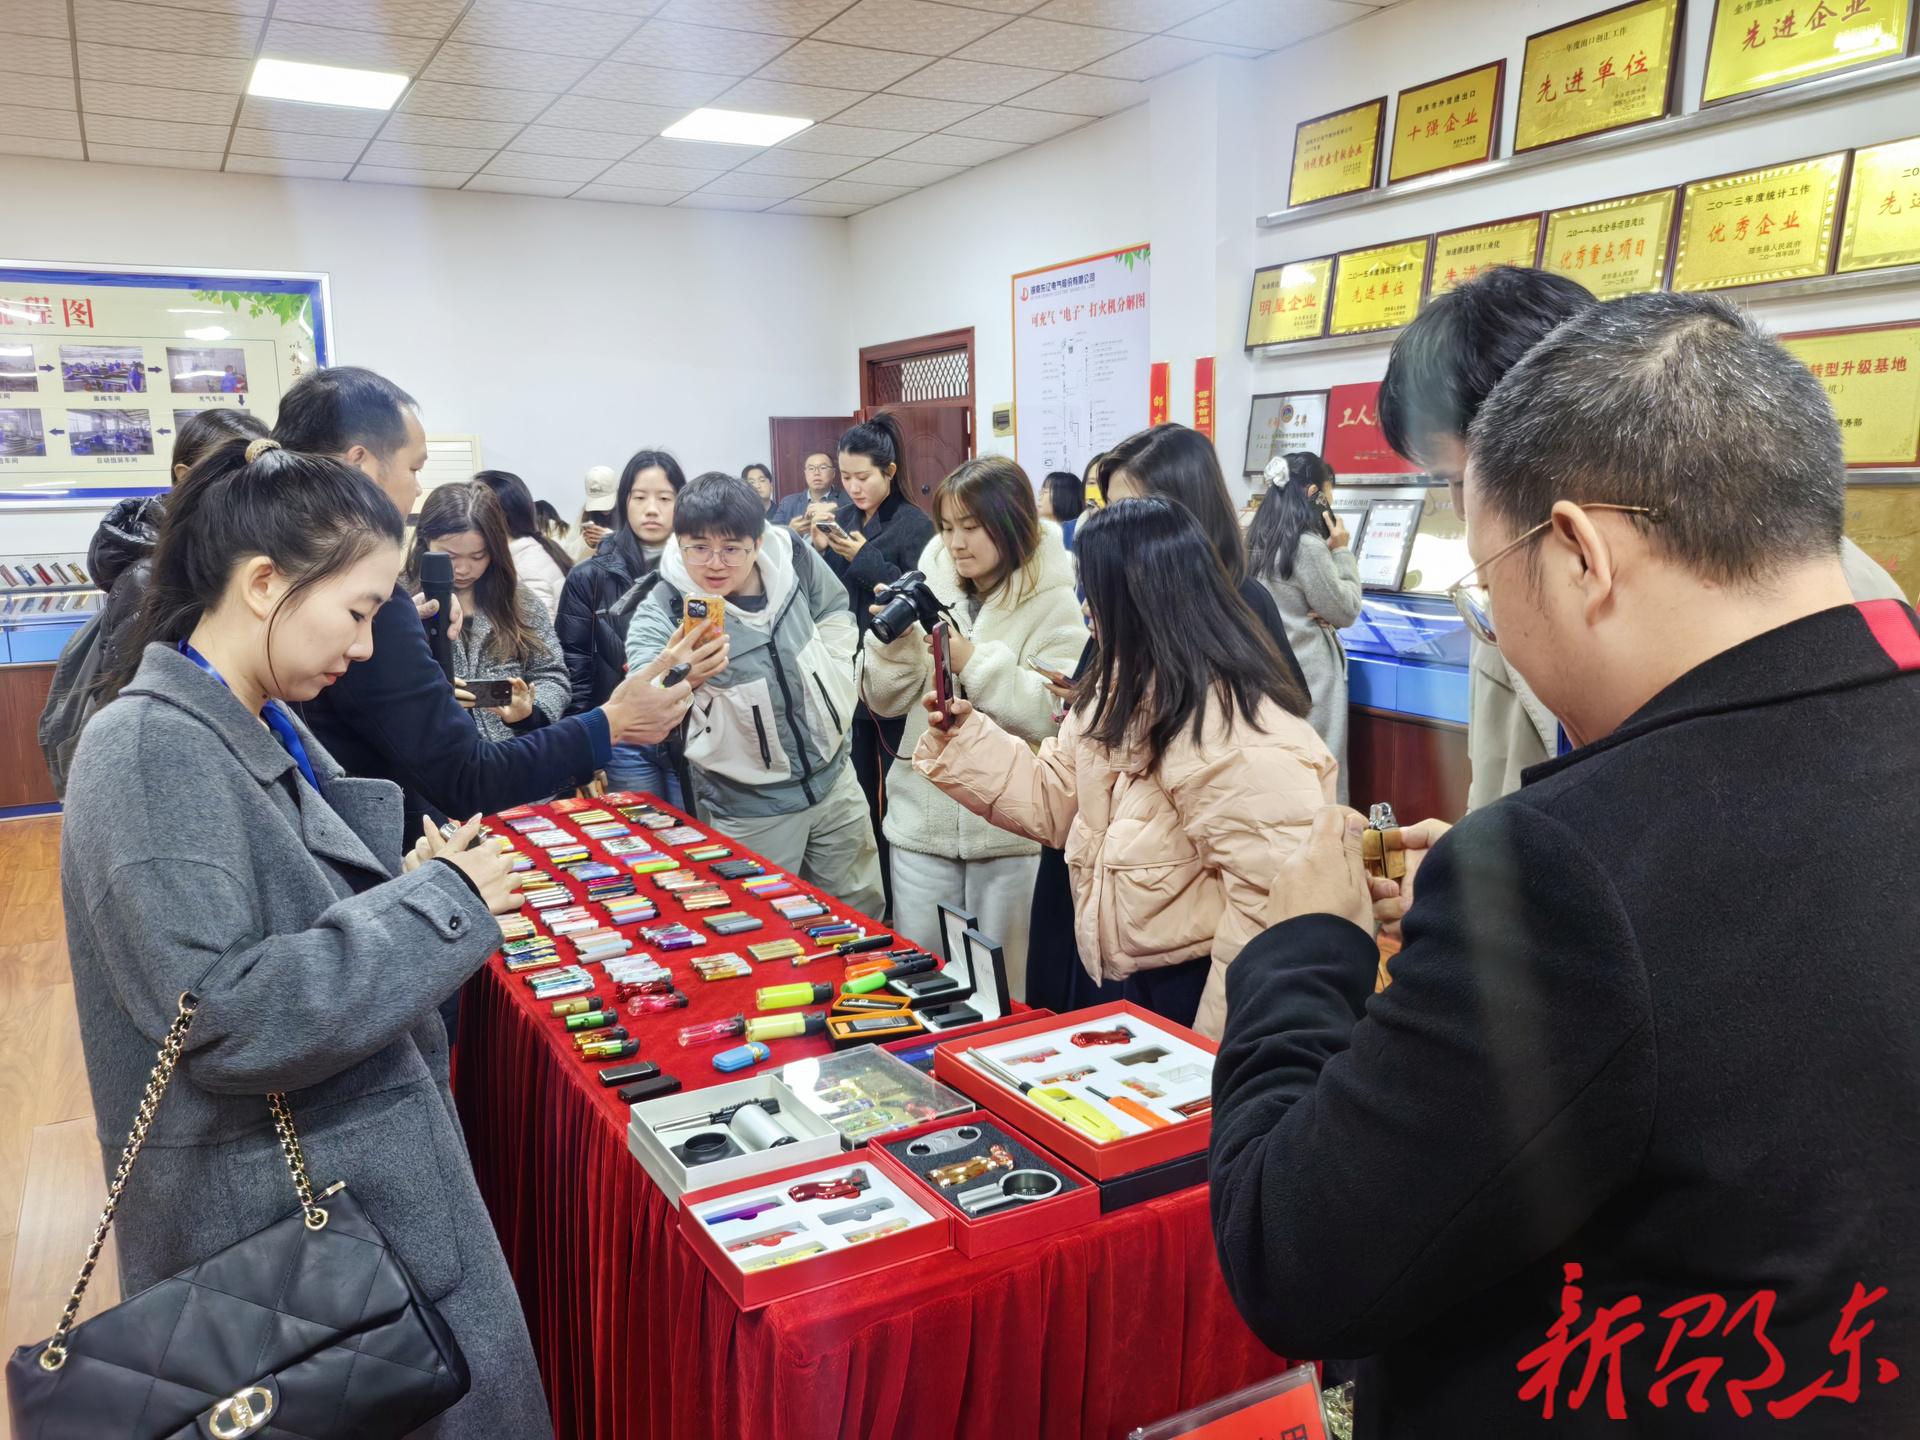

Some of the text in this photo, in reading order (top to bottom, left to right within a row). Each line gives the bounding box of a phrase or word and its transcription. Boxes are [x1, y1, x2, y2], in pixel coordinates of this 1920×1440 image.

[1536, 50, 1648, 104] 先进单位
[1407, 107, 1478, 142] 十强企业
[1707, 210, 1800, 243] 优秀企业
[1560, 237, 1646, 271] 优秀重点项目
[1748, 240, 1802, 255] 邵东县人民政府
[1030, 272, 1096, 295] 湖南东亿电气股份有限公司
[1352, 280, 1404, 303] 先进单位
[1259, 292, 1317, 317] 明星企业
